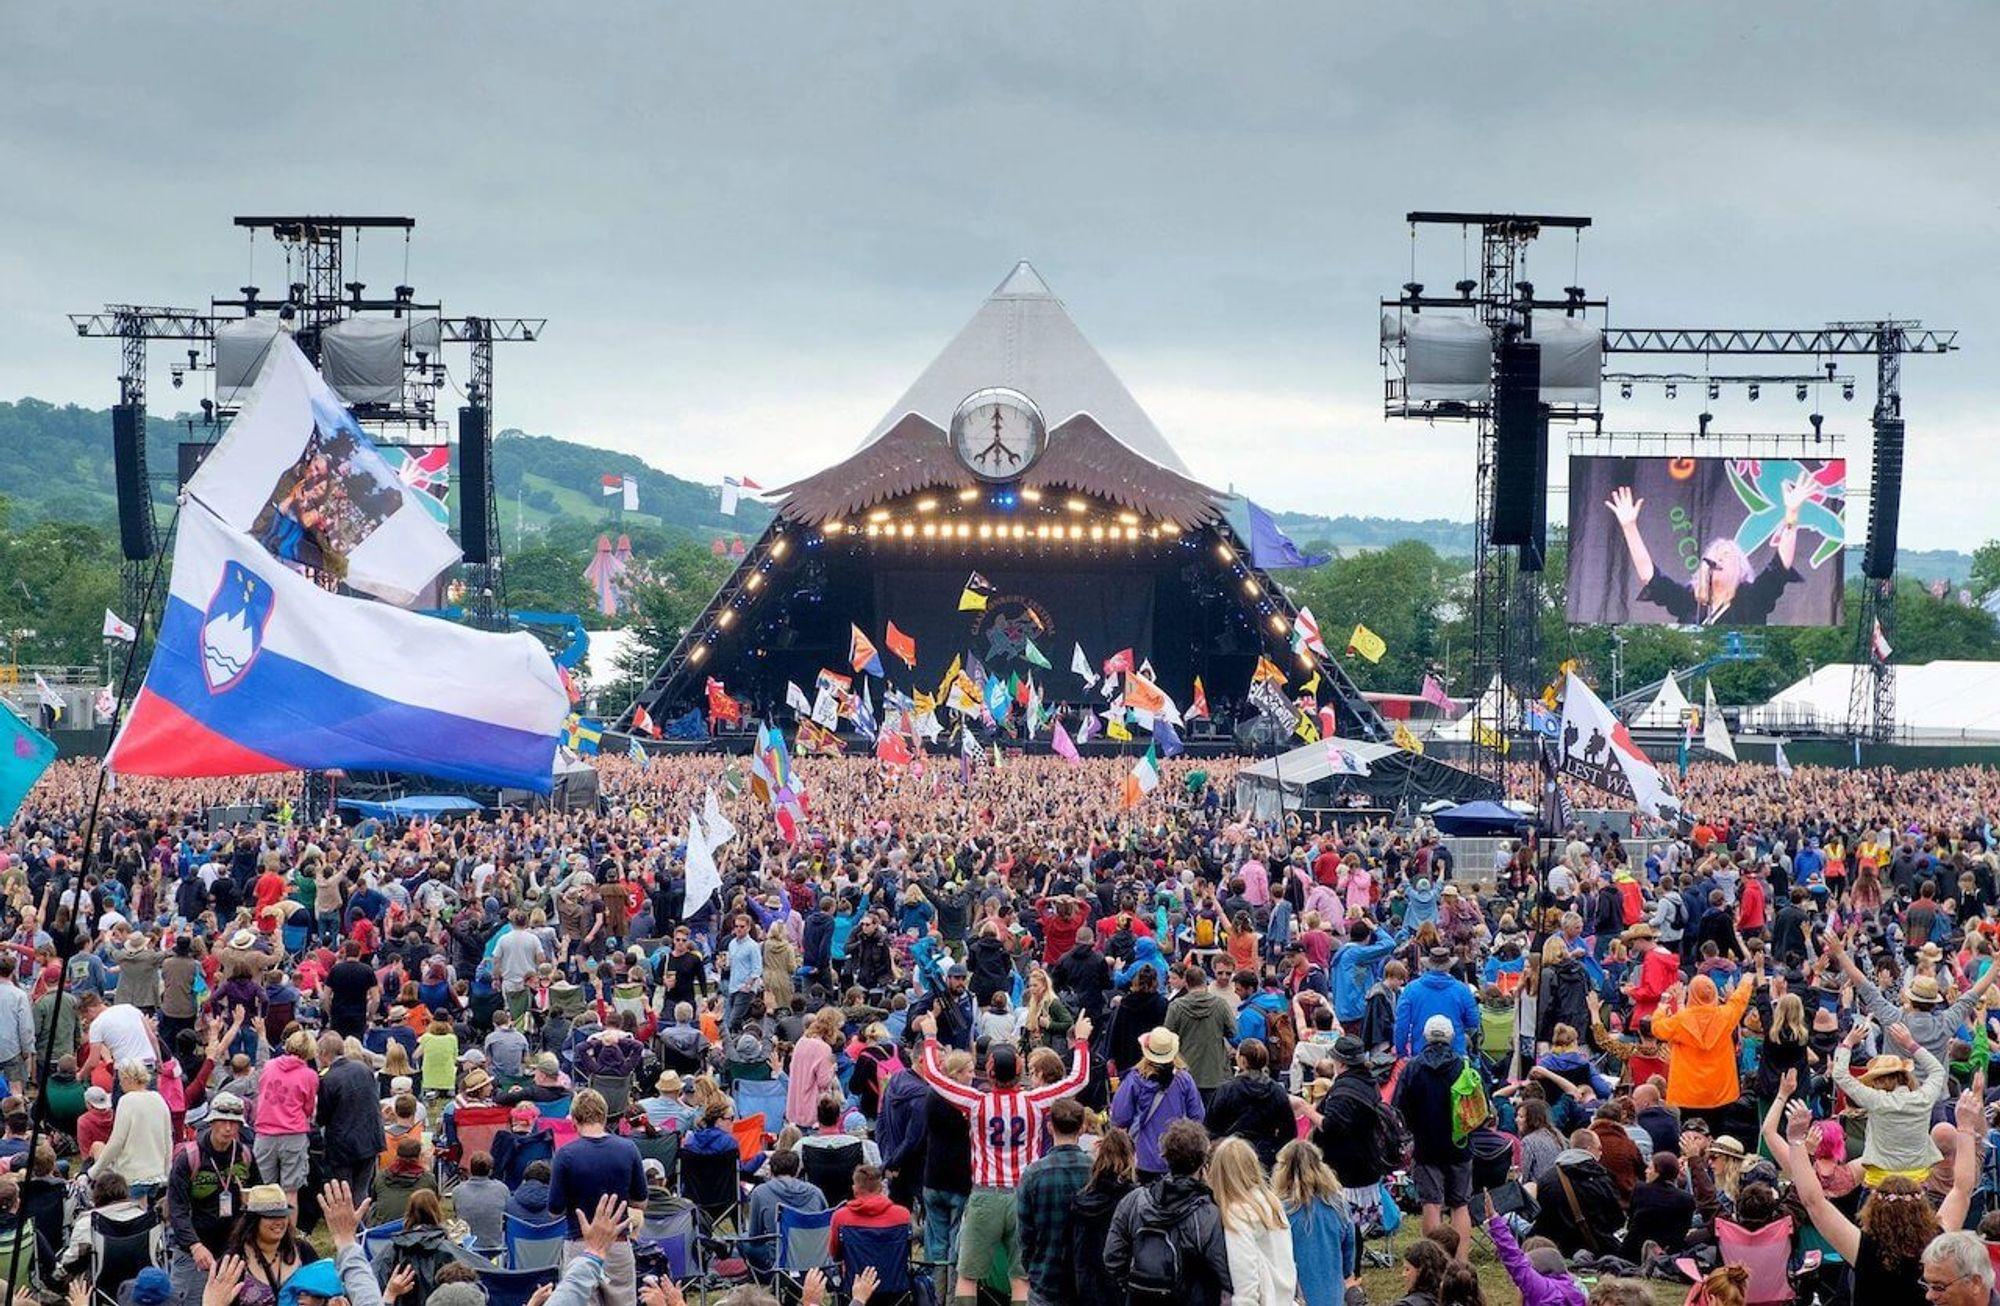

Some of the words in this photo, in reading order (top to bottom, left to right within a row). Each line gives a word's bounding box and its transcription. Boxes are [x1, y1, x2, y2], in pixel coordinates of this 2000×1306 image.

[1670, 506, 1692, 532] of
[1566, 758, 1601, 783] LEST
[1607, 774, 1632, 795] WE
[628, 893, 638, 908] 5
[989, 1116, 1025, 1147] 22
